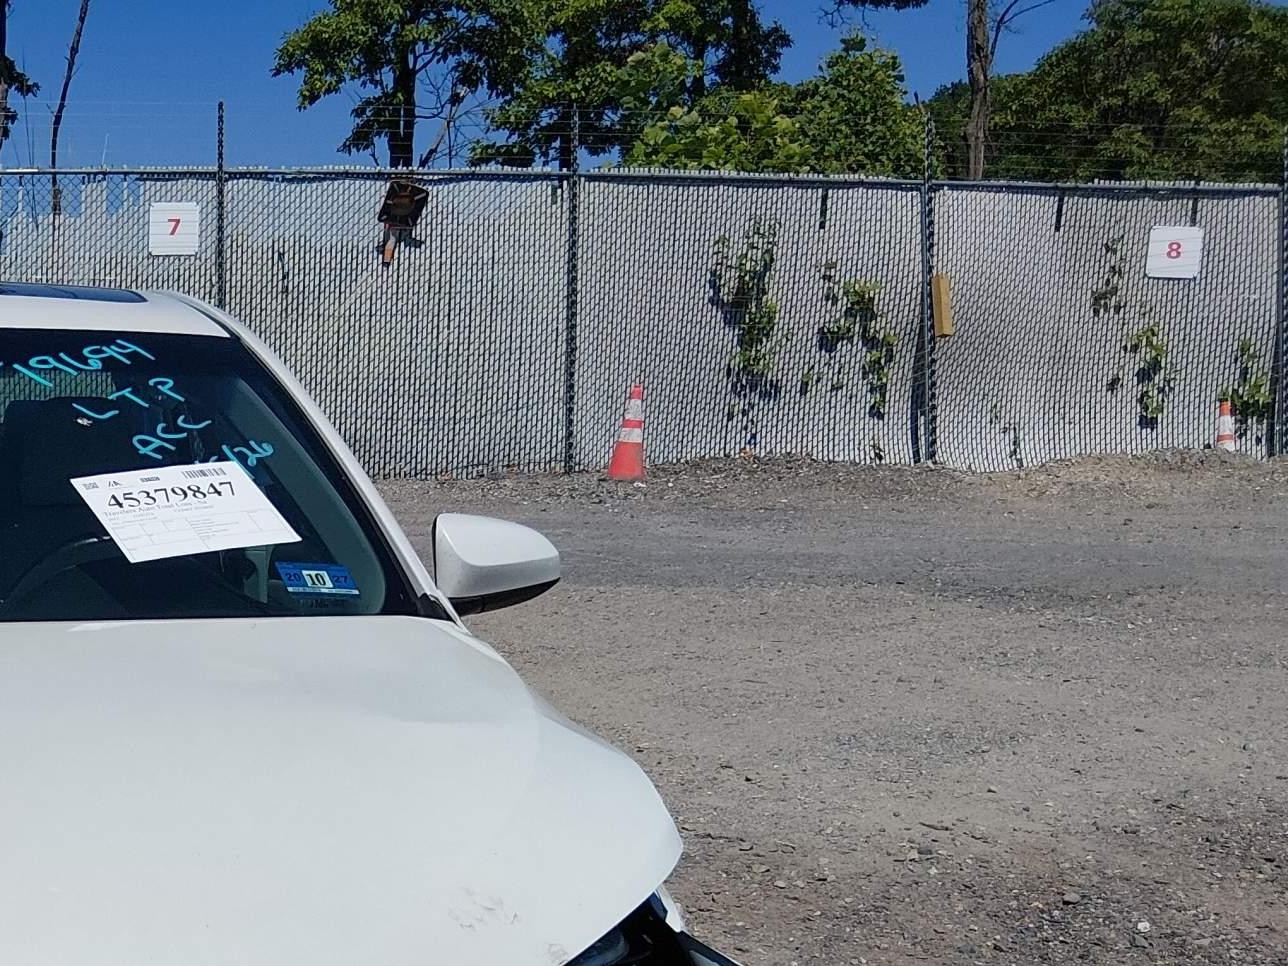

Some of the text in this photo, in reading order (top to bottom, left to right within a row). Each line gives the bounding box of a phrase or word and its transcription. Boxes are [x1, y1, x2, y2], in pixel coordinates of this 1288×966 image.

[167, 218, 181, 236] 7
[1166, 242, 1182, 260] 8
[108, 481, 235, 510] 45379847
[285, 572, 348, 586] 20 10 27
